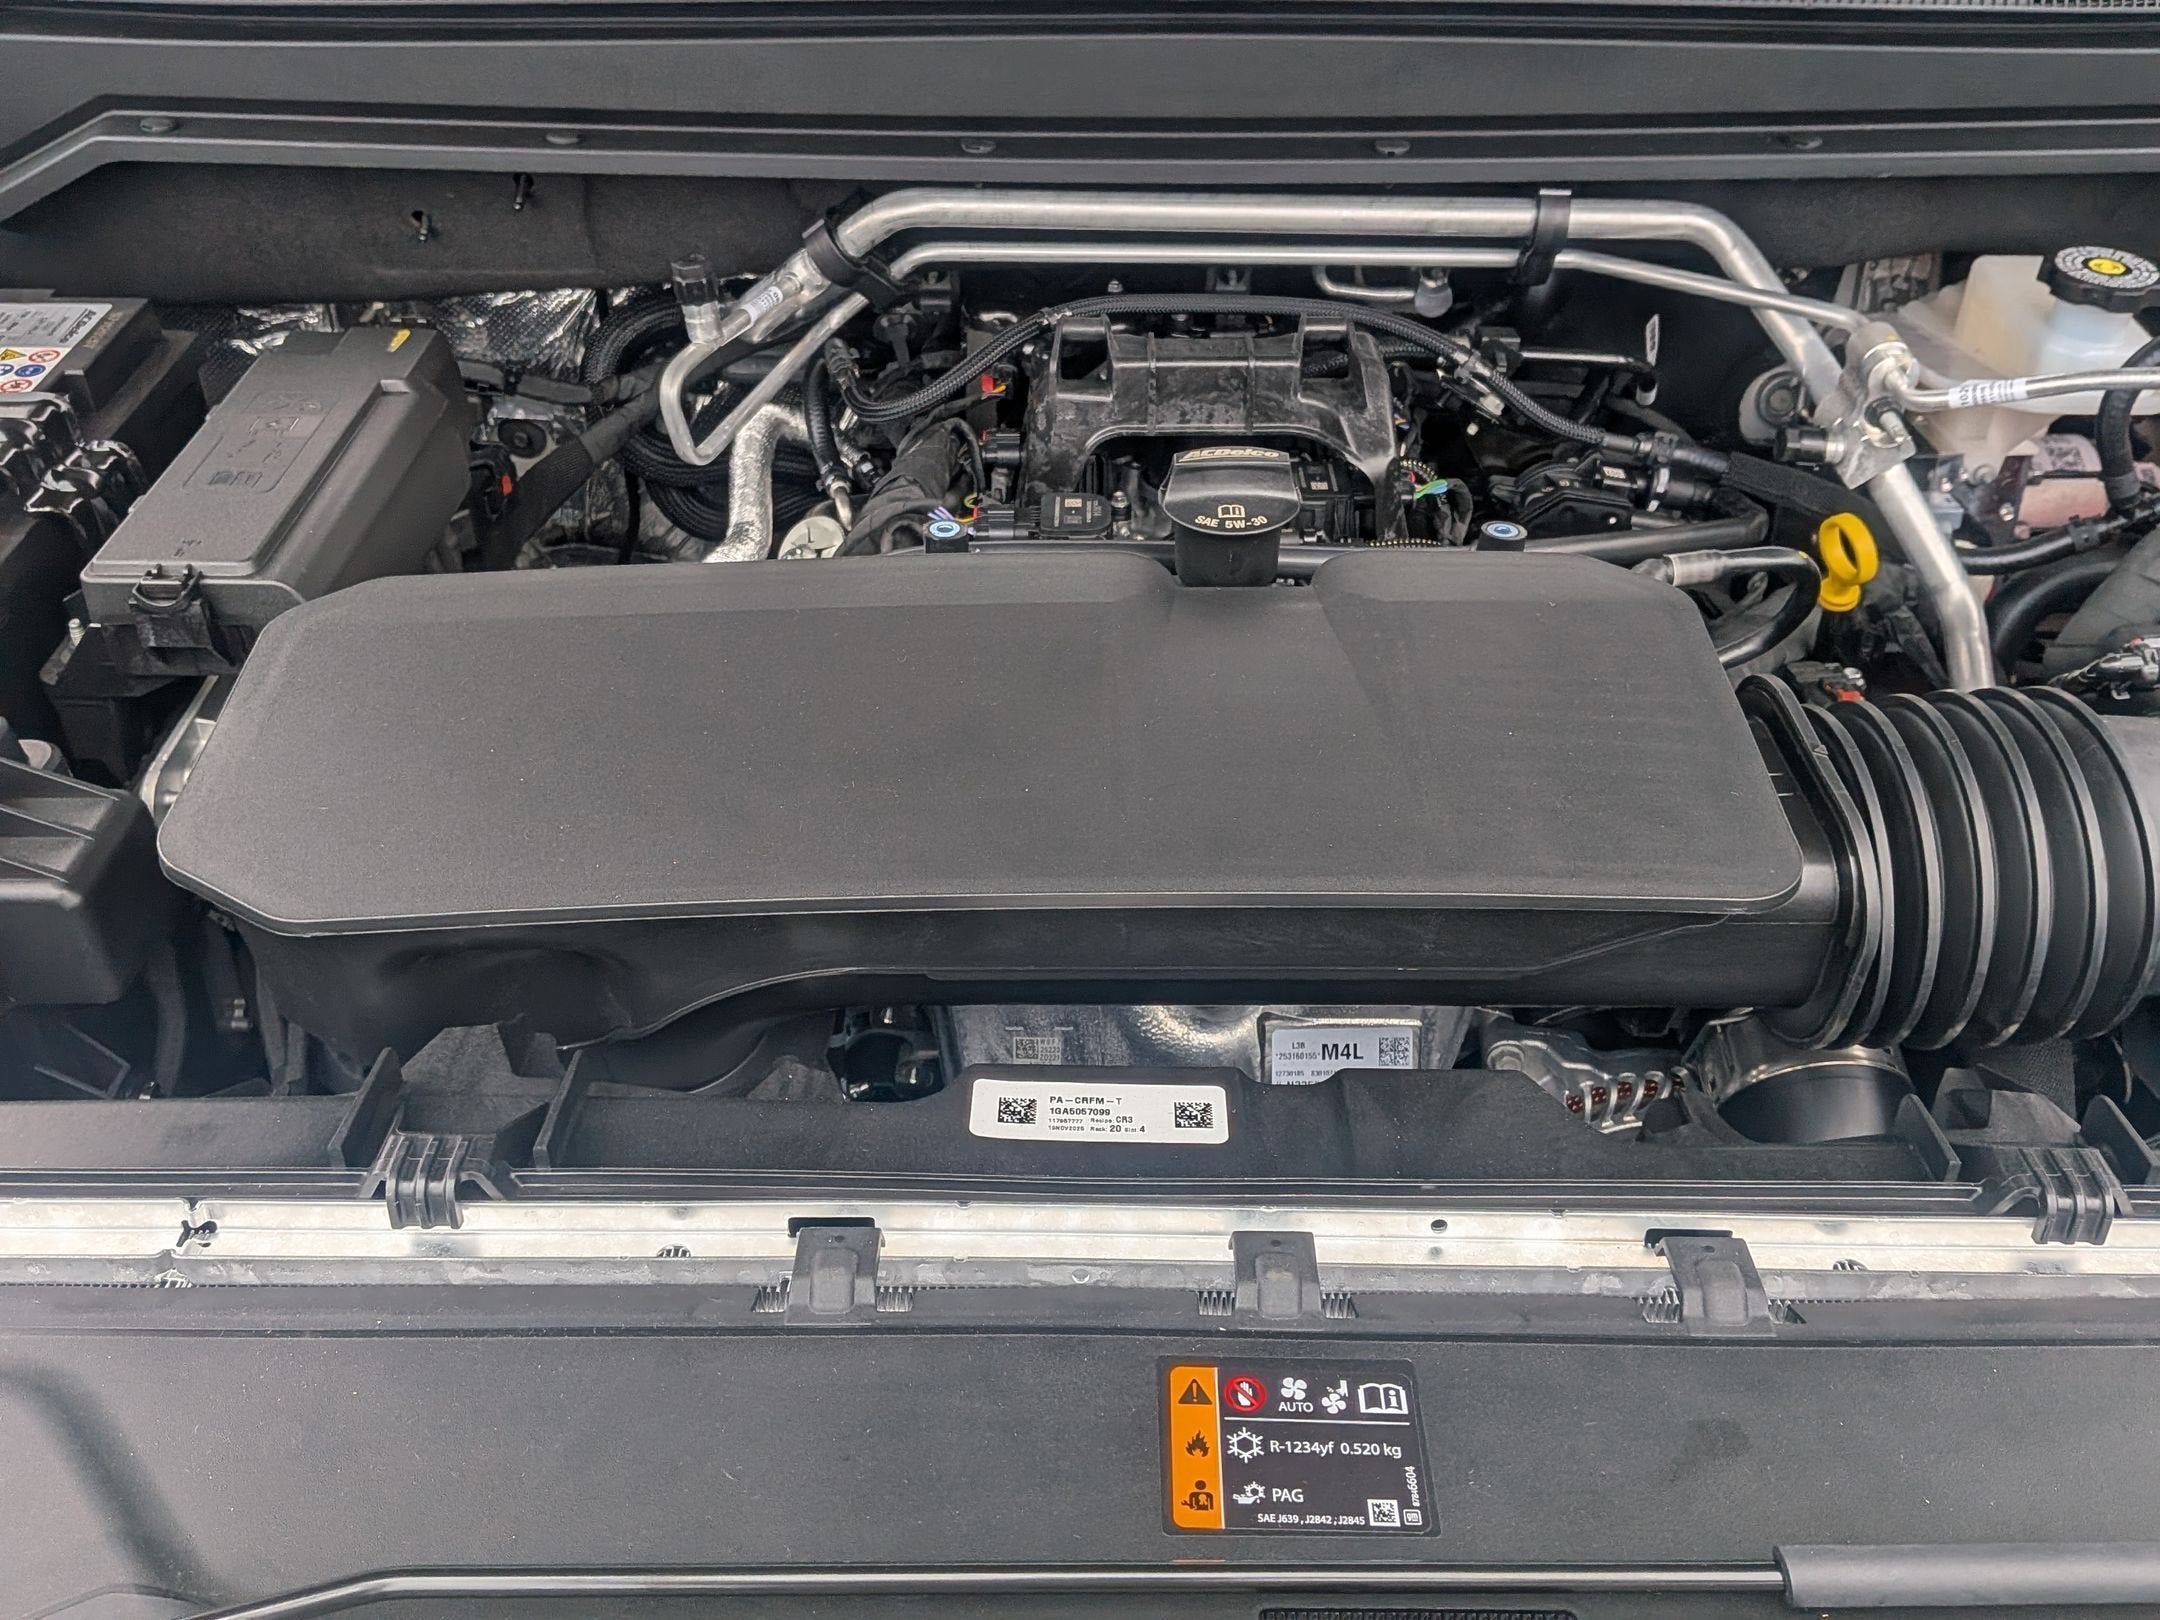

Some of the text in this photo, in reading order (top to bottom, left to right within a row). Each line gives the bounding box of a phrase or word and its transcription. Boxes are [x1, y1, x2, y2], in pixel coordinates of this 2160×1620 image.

[1180, 448, 1280, 461] ACDelco
[1194, 515, 1268, 529] SAE 5W-30
[1321, 1042, 1364, 1061] M4L
[1049, 1107, 1111, 1116] 1GA5057099
[1115, 1116, 1133, 1124] CR3
[1109, 1124, 1122, 1133] 20
[1139, 1125, 1146, 1133] 4
[1278, 1401, 1314, 1413] AUTO
[1269, 1440, 1402, 1459] R-1234yf 0.520 kg
[1272, 1488, 1304, 1503] PAG
[1257, 1513, 1276, 1523] SAE
